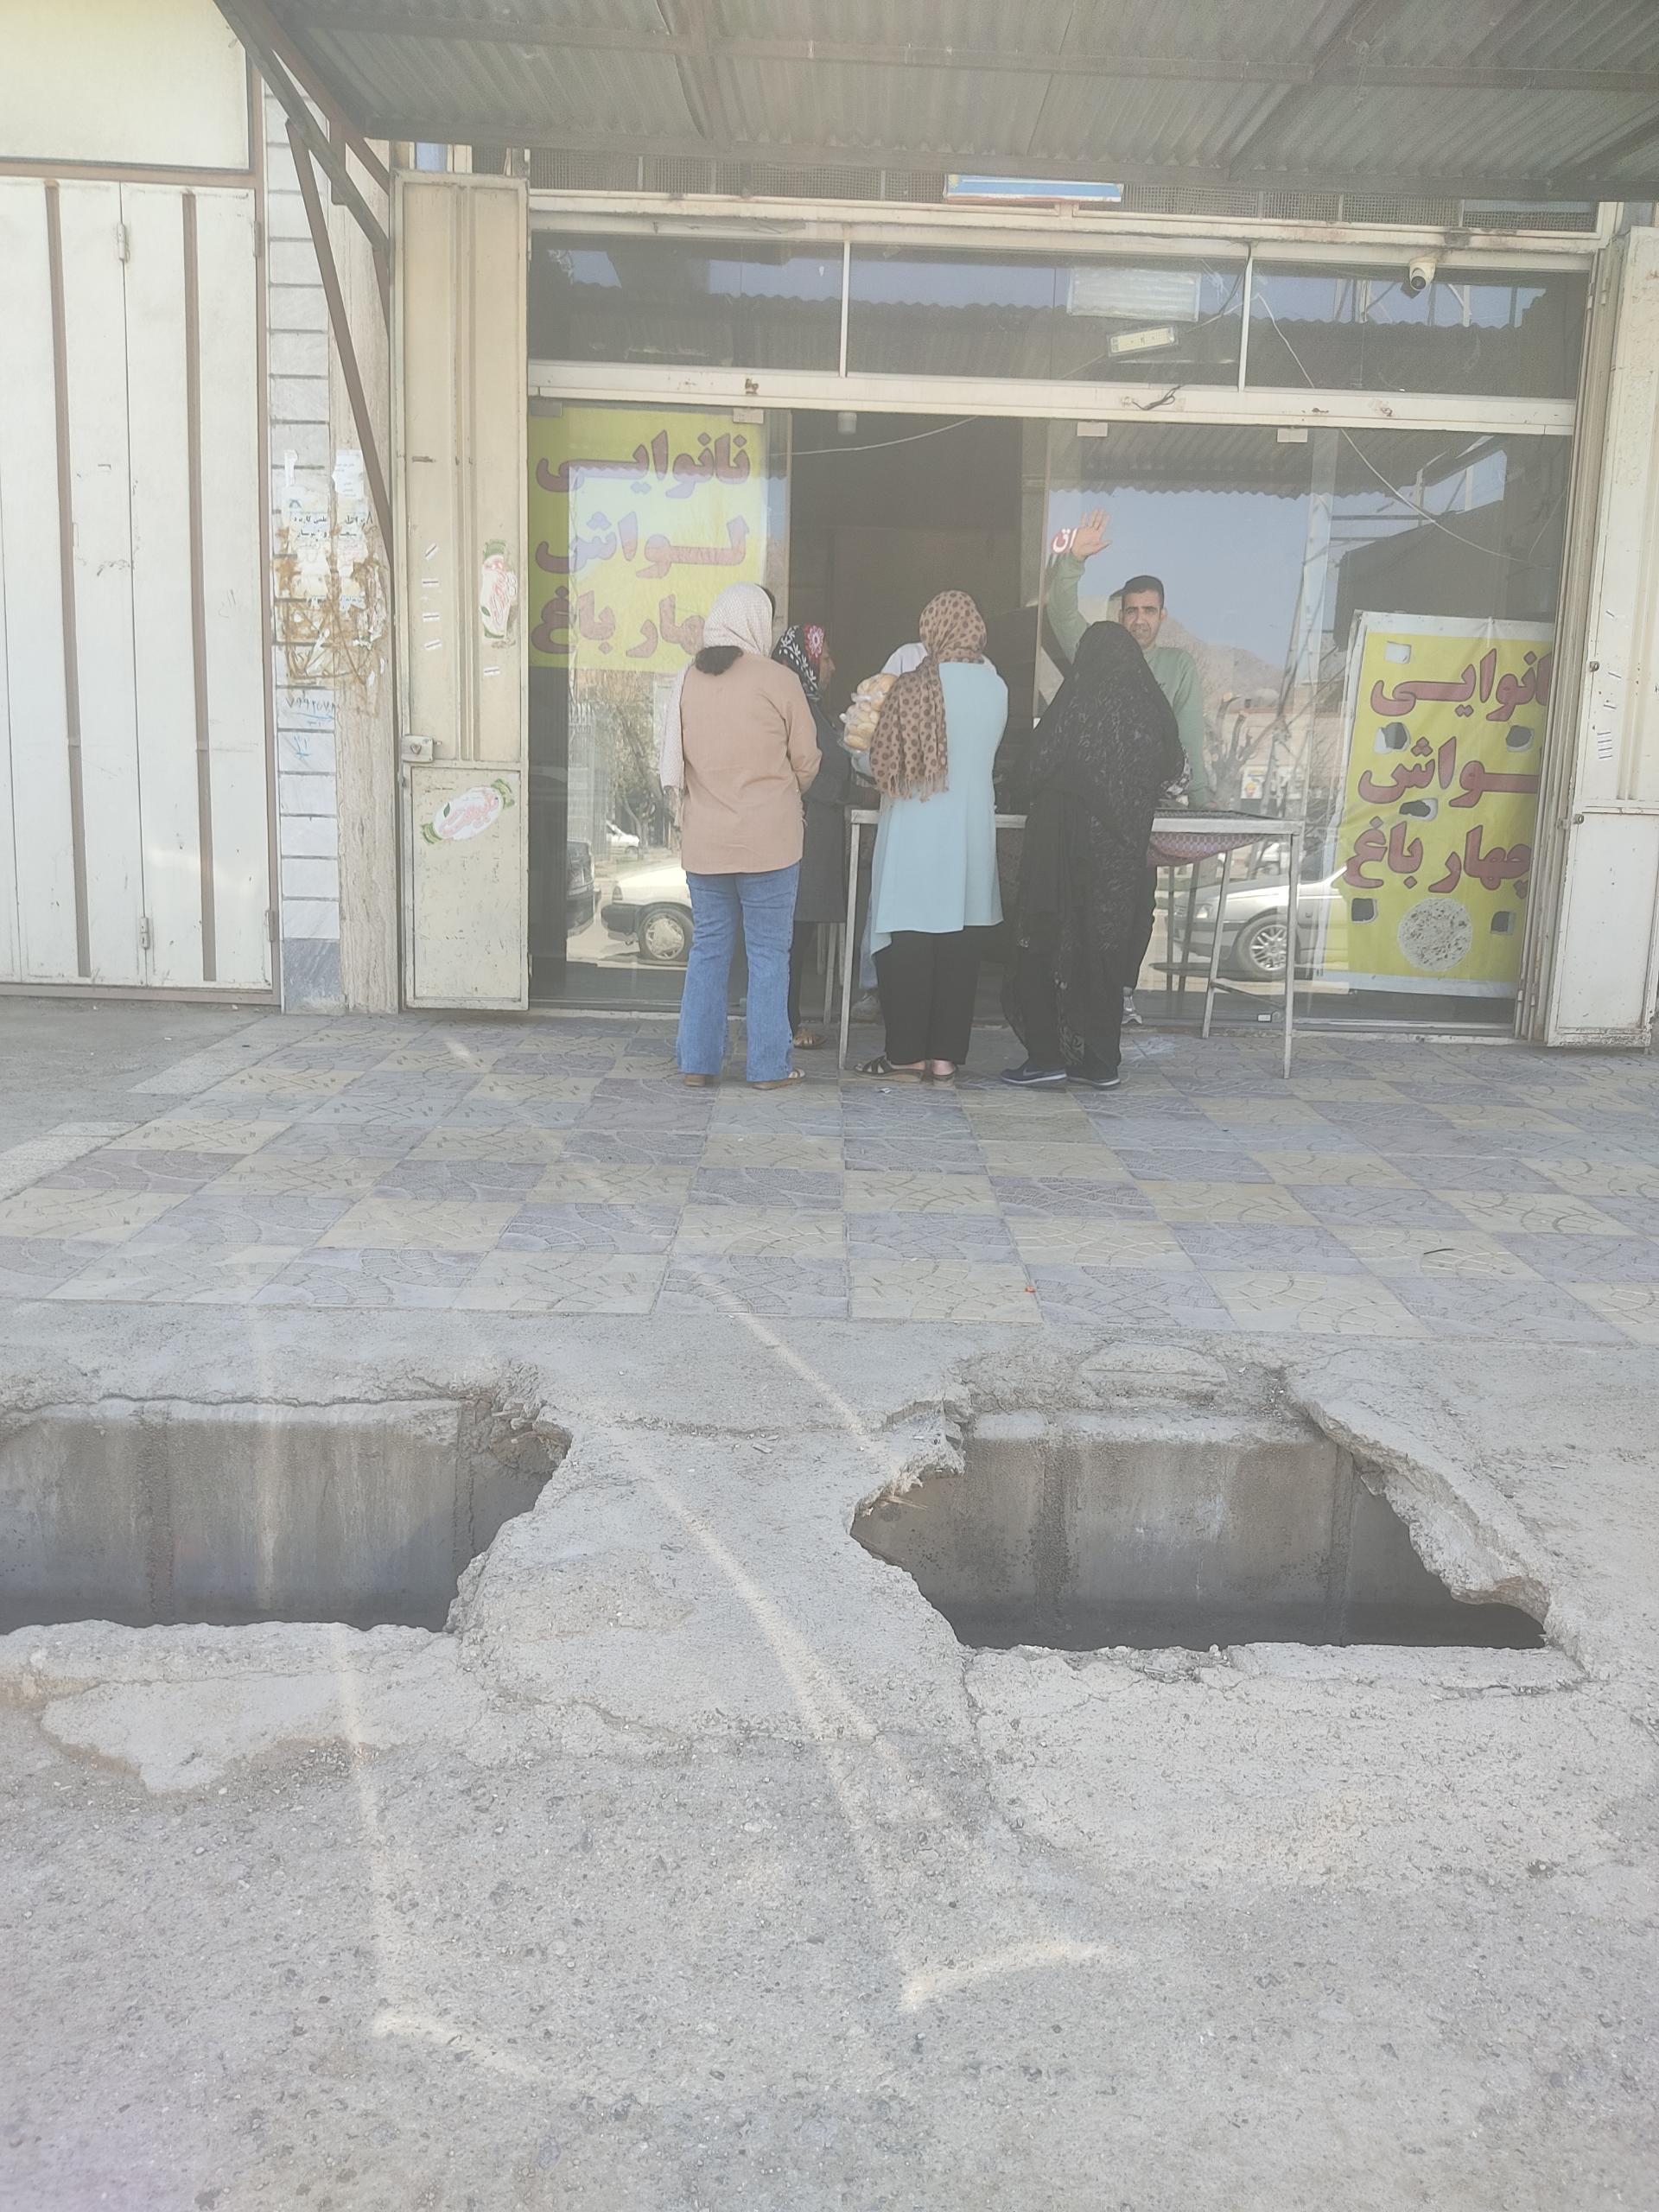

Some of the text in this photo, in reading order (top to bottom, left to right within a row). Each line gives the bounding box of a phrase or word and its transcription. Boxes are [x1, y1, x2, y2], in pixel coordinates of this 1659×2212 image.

[535, 430, 751, 499] نانوایی
[531, 586, 616, 655] باغ
[625, 594, 706, 658] هار
[1370, 648, 1552, 722] انوایی
[1357, 736, 1541, 809] واش
[1341, 816, 1424, 890] باغ
